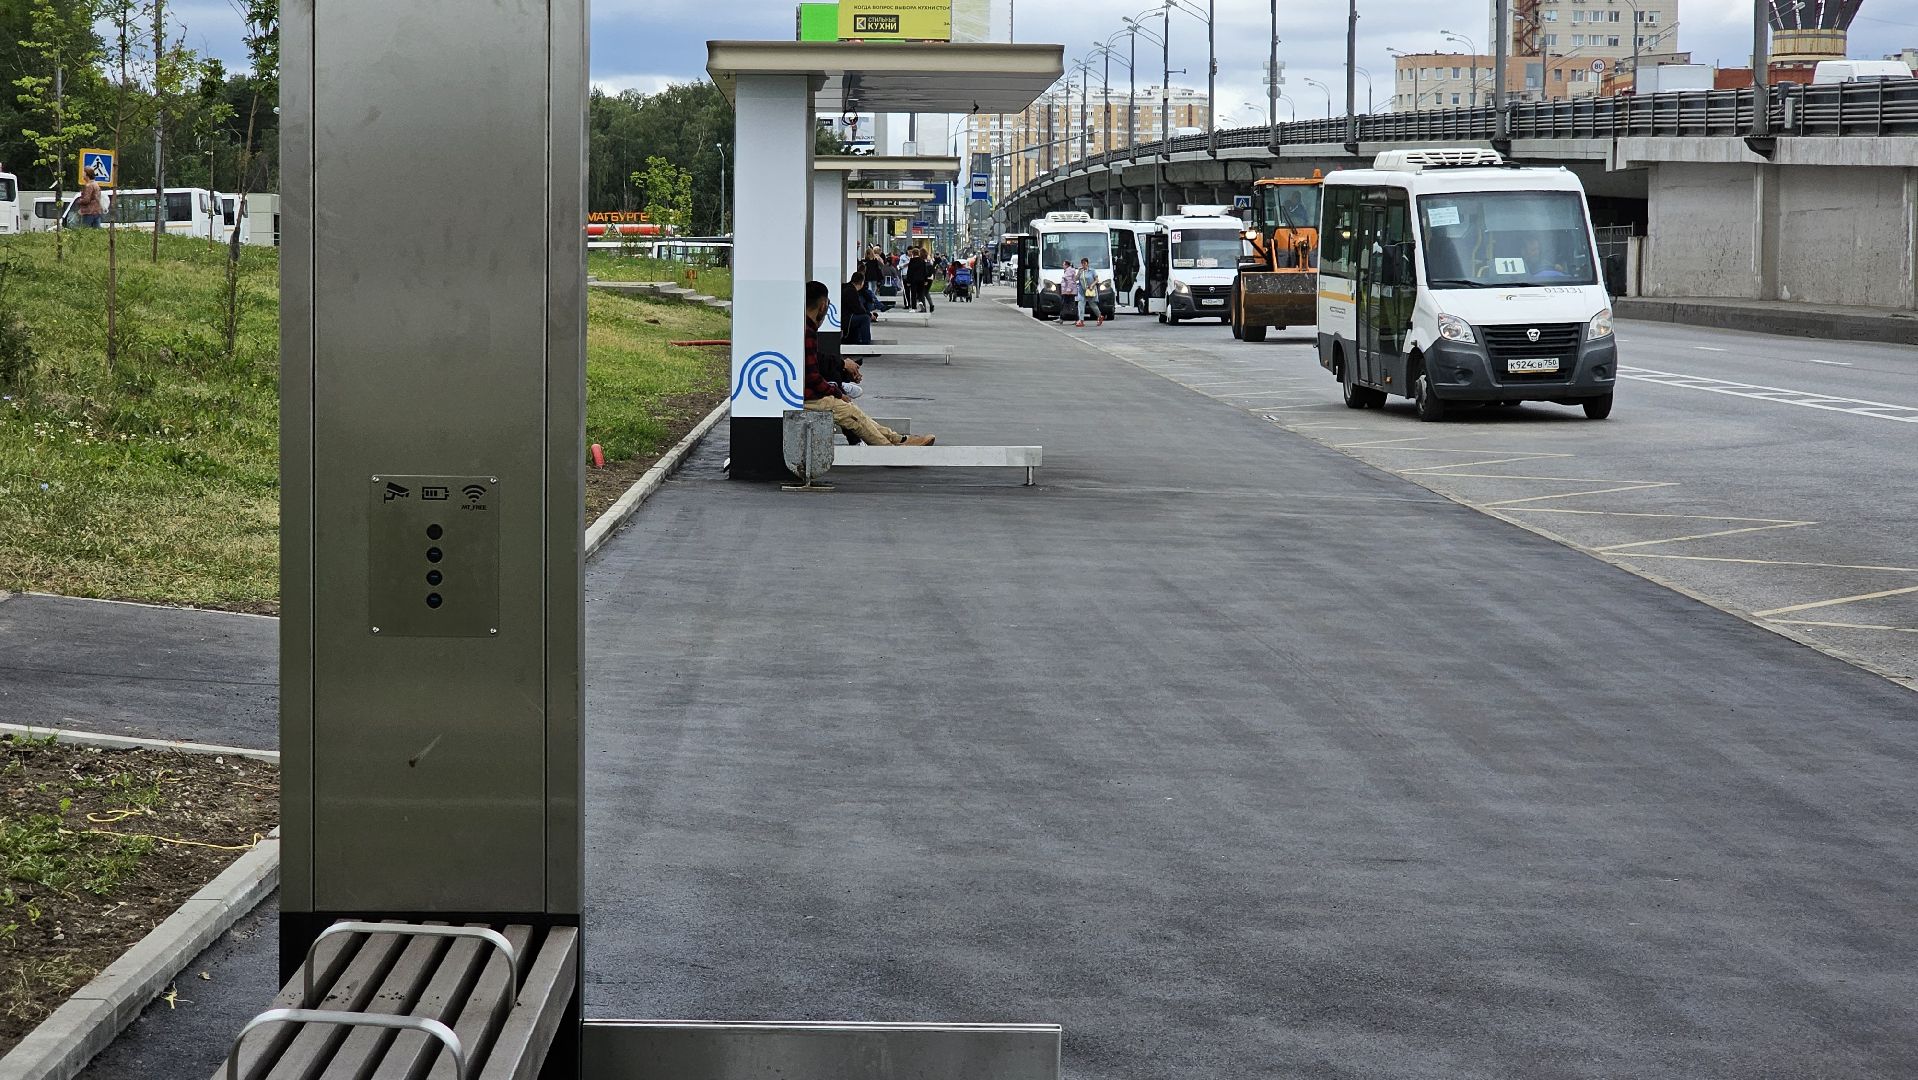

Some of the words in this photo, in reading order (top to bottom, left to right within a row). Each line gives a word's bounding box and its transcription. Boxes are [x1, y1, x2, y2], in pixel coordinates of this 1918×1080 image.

[868, 22, 897, 30] КУХНИ
[588, 212, 651, 222] МАГБУРГЕ
[1172, 233, 1181, 241] 45
[1502, 260, 1518, 273] 11
